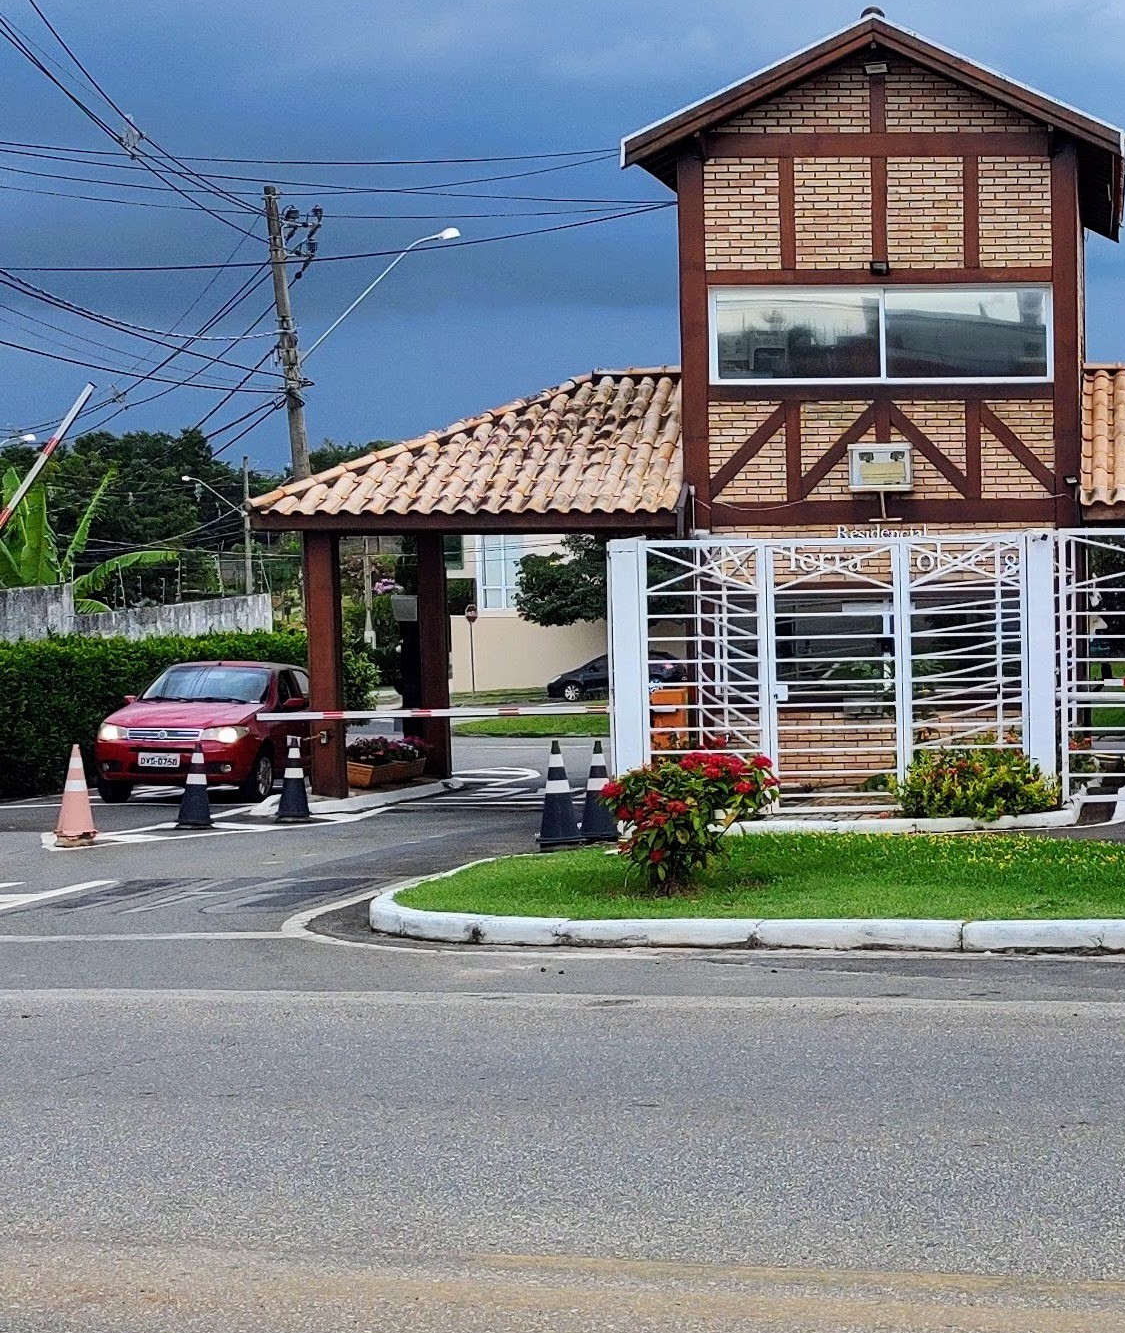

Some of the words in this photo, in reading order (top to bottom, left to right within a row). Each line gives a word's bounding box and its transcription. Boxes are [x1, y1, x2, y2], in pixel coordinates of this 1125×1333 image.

[837, 524, 929, 539] Residencial
[782, 542, 864, 573] Terra
[888, 543, 987, 573] obe
